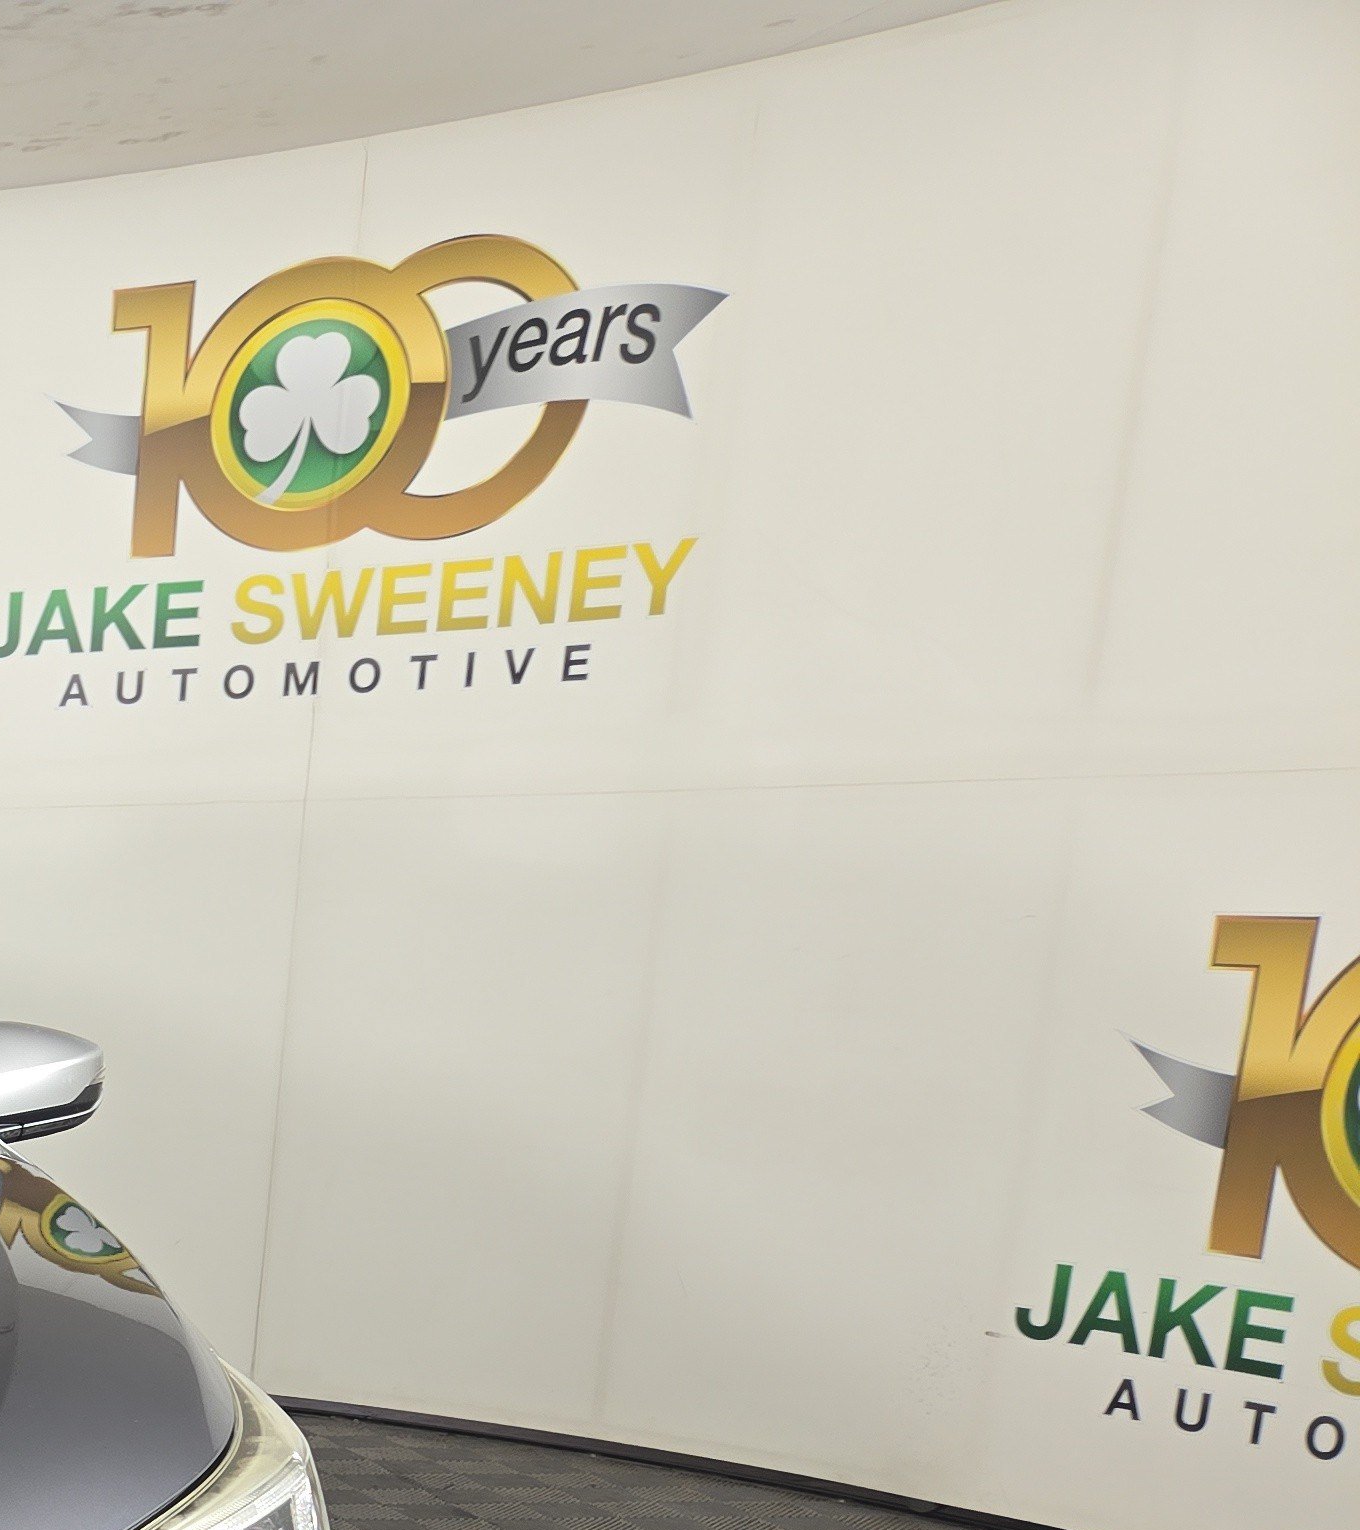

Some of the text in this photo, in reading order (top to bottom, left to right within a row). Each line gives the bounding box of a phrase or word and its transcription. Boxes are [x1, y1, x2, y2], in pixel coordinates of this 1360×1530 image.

[112, 233, 661, 558] 100 years
[231, 537, 698, 645] SWEENEY
[59, 643, 592, 708] AUTOMOTIVE
[1014, 1263, 1295, 1380] JAKE
[1103, 1379, 1345, 1461] AUTO
